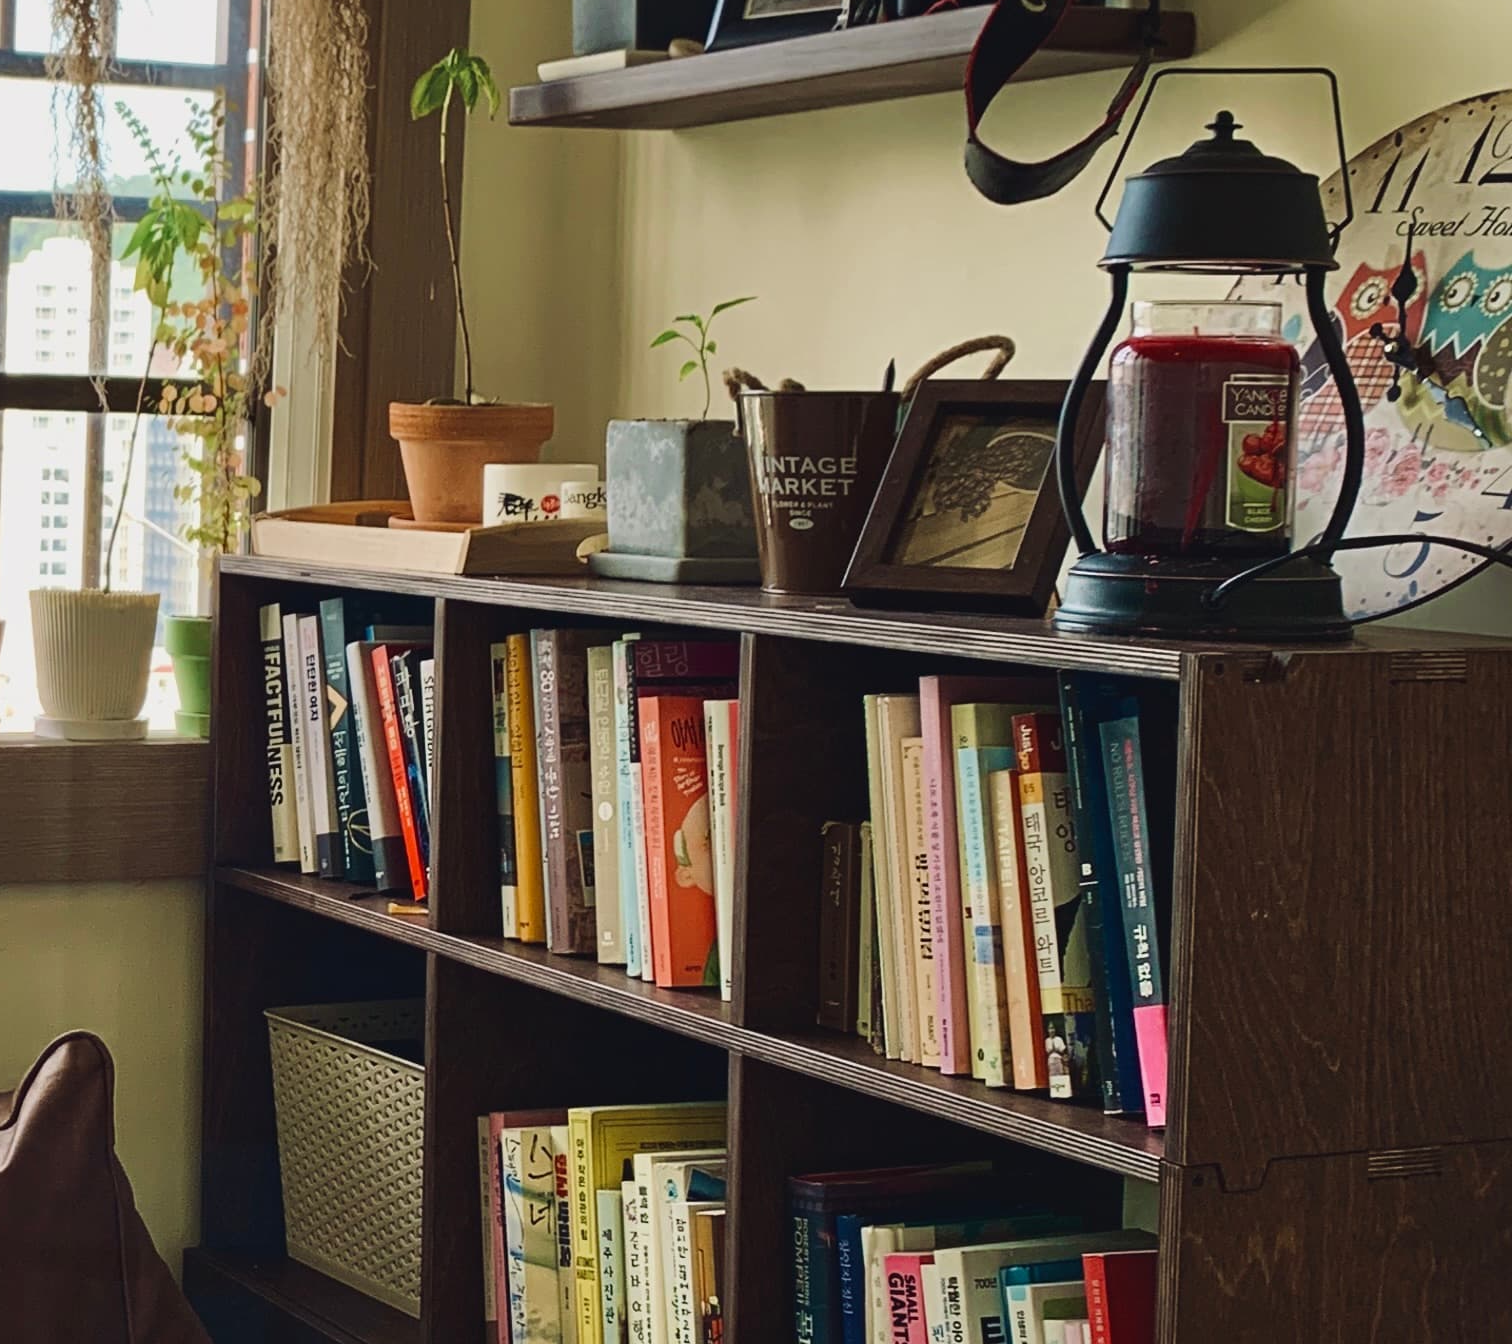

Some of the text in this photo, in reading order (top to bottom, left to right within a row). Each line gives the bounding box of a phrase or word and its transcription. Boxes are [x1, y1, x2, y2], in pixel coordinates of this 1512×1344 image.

[1396, 206, 1471, 238] Sweet
[760, 477, 855, 495] MARKET
[306, 654, 319, 721] 단단한 여자
[594, 668, 609, 713] 퇴근길
[265, 654, 283, 807] FACTFULNESS
[333, 730, 347, 768] 해석
[596, 716, 610, 761] 인문학
[1110, 743, 1120, 761] NO
[1111, 765, 1126, 813] RULES
[998, 822, 1012, 887] TAIPEI
[1037, 934, 1056, 974] 와트
[1133, 924, 1154, 999] 규칙 없음
[577, 1139, 585, 1160] 아주
[794, 1216, 806, 1304] POMPEII
[904, 1274, 919, 1323] SMALL
